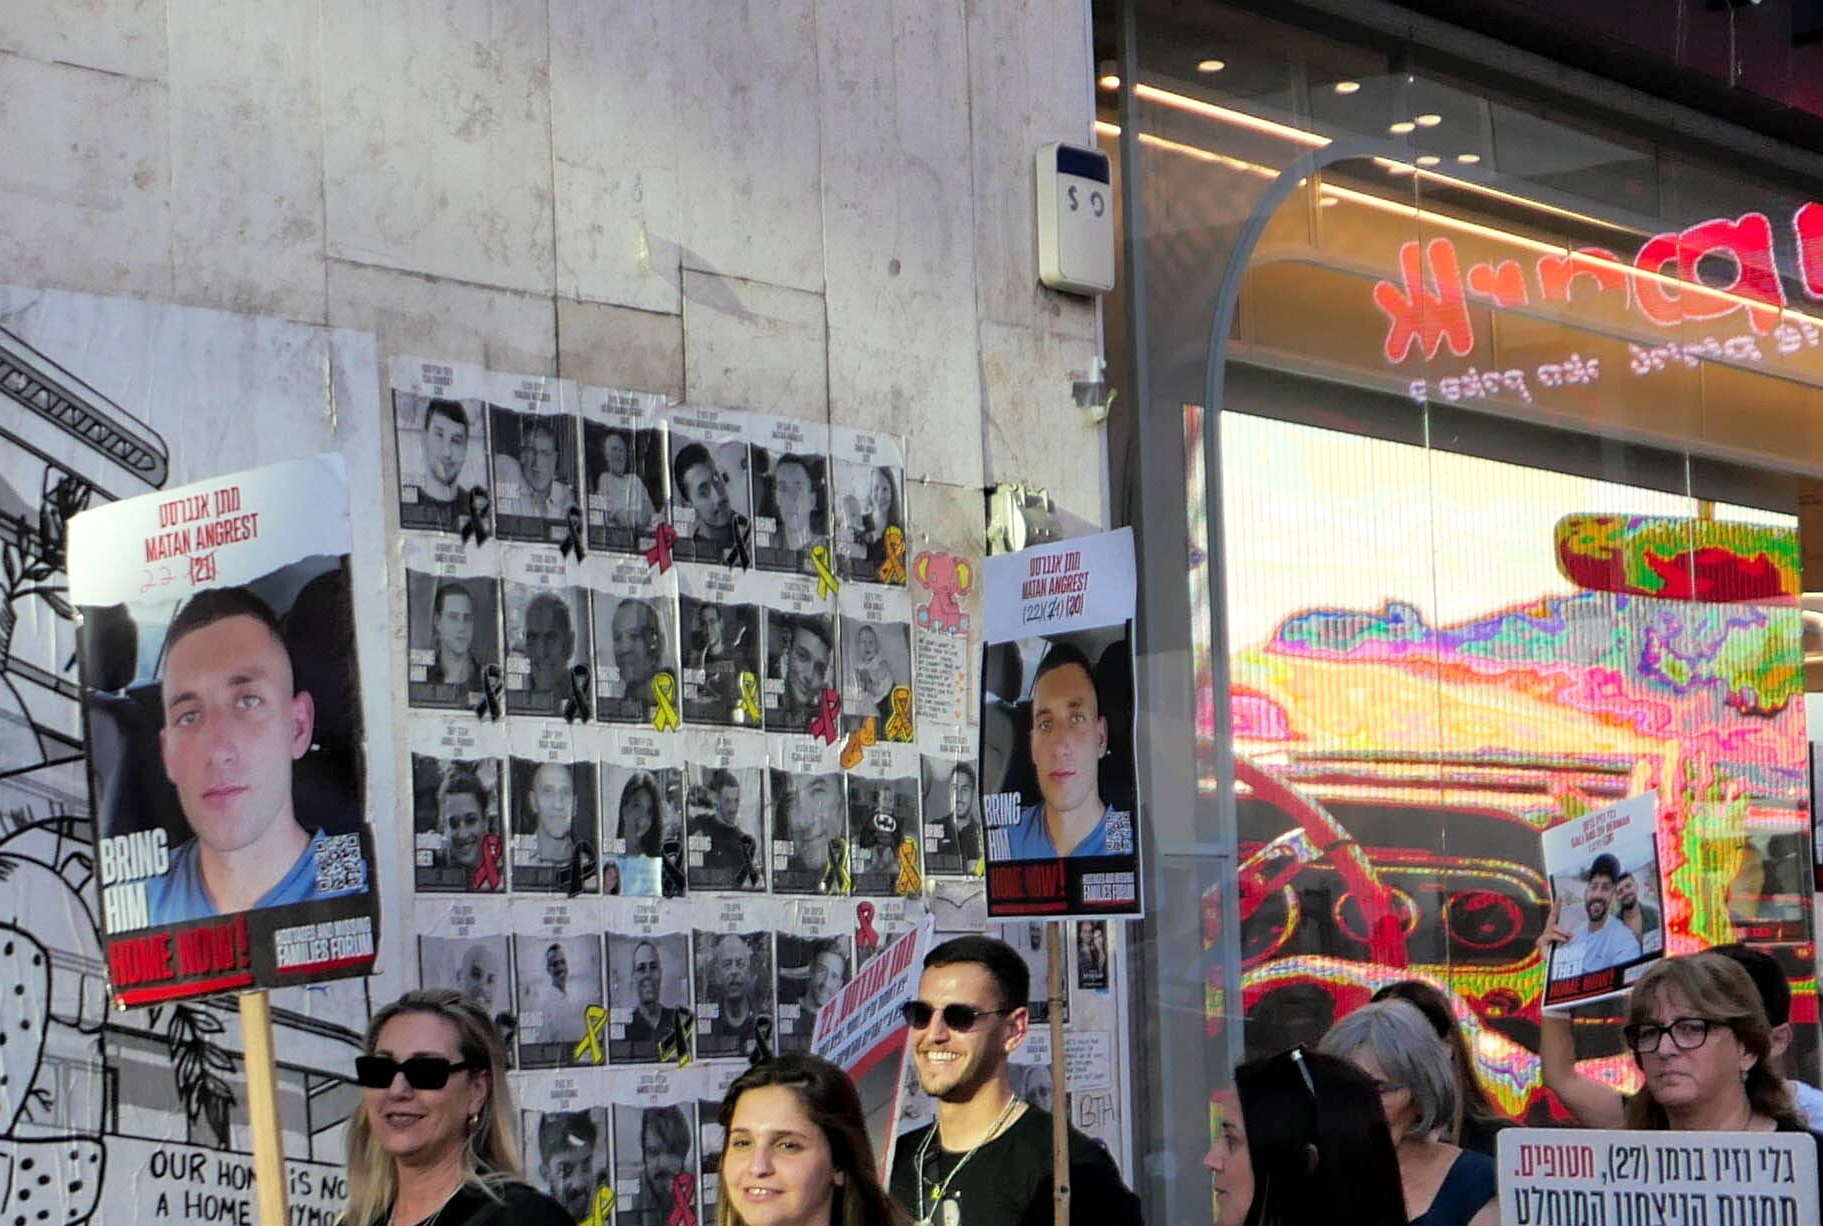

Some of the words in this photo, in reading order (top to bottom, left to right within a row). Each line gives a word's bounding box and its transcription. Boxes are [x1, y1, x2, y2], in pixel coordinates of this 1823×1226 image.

[159, 493, 210, 529] אנגרסט
[214, 485, 241, 519] מתן
[145, 528, 192, 563] MATAN
[196, 511, 259, 551] ANGREST
[1021, 577, 1048, 600] MATAN
[1049, 571, 1089, 596] ANGREST
[983, 791, 1021, 827] BRING
[99, 827, 170, 886] BRING
[987, 827, 1012, 862] HIM
[103, 882, 150, 935] HIM
[107, 932, 176, 988] HOME
[178, 912, 251, 977] NOW!
[277, 938, 329, 969] FAMILIES
[330, 931, 375, 961] FORUM
[151, 1150, 207, 1185] OUR
[1656, 1145, 1707, 1184] ברמן
[1712, 1146, 1752, 1182] וזיו
[1758, 1146, 1795, 1184] גלי
[156, 1191, 169, 1217] A
[184, 1190, 252, 1226] HOME
